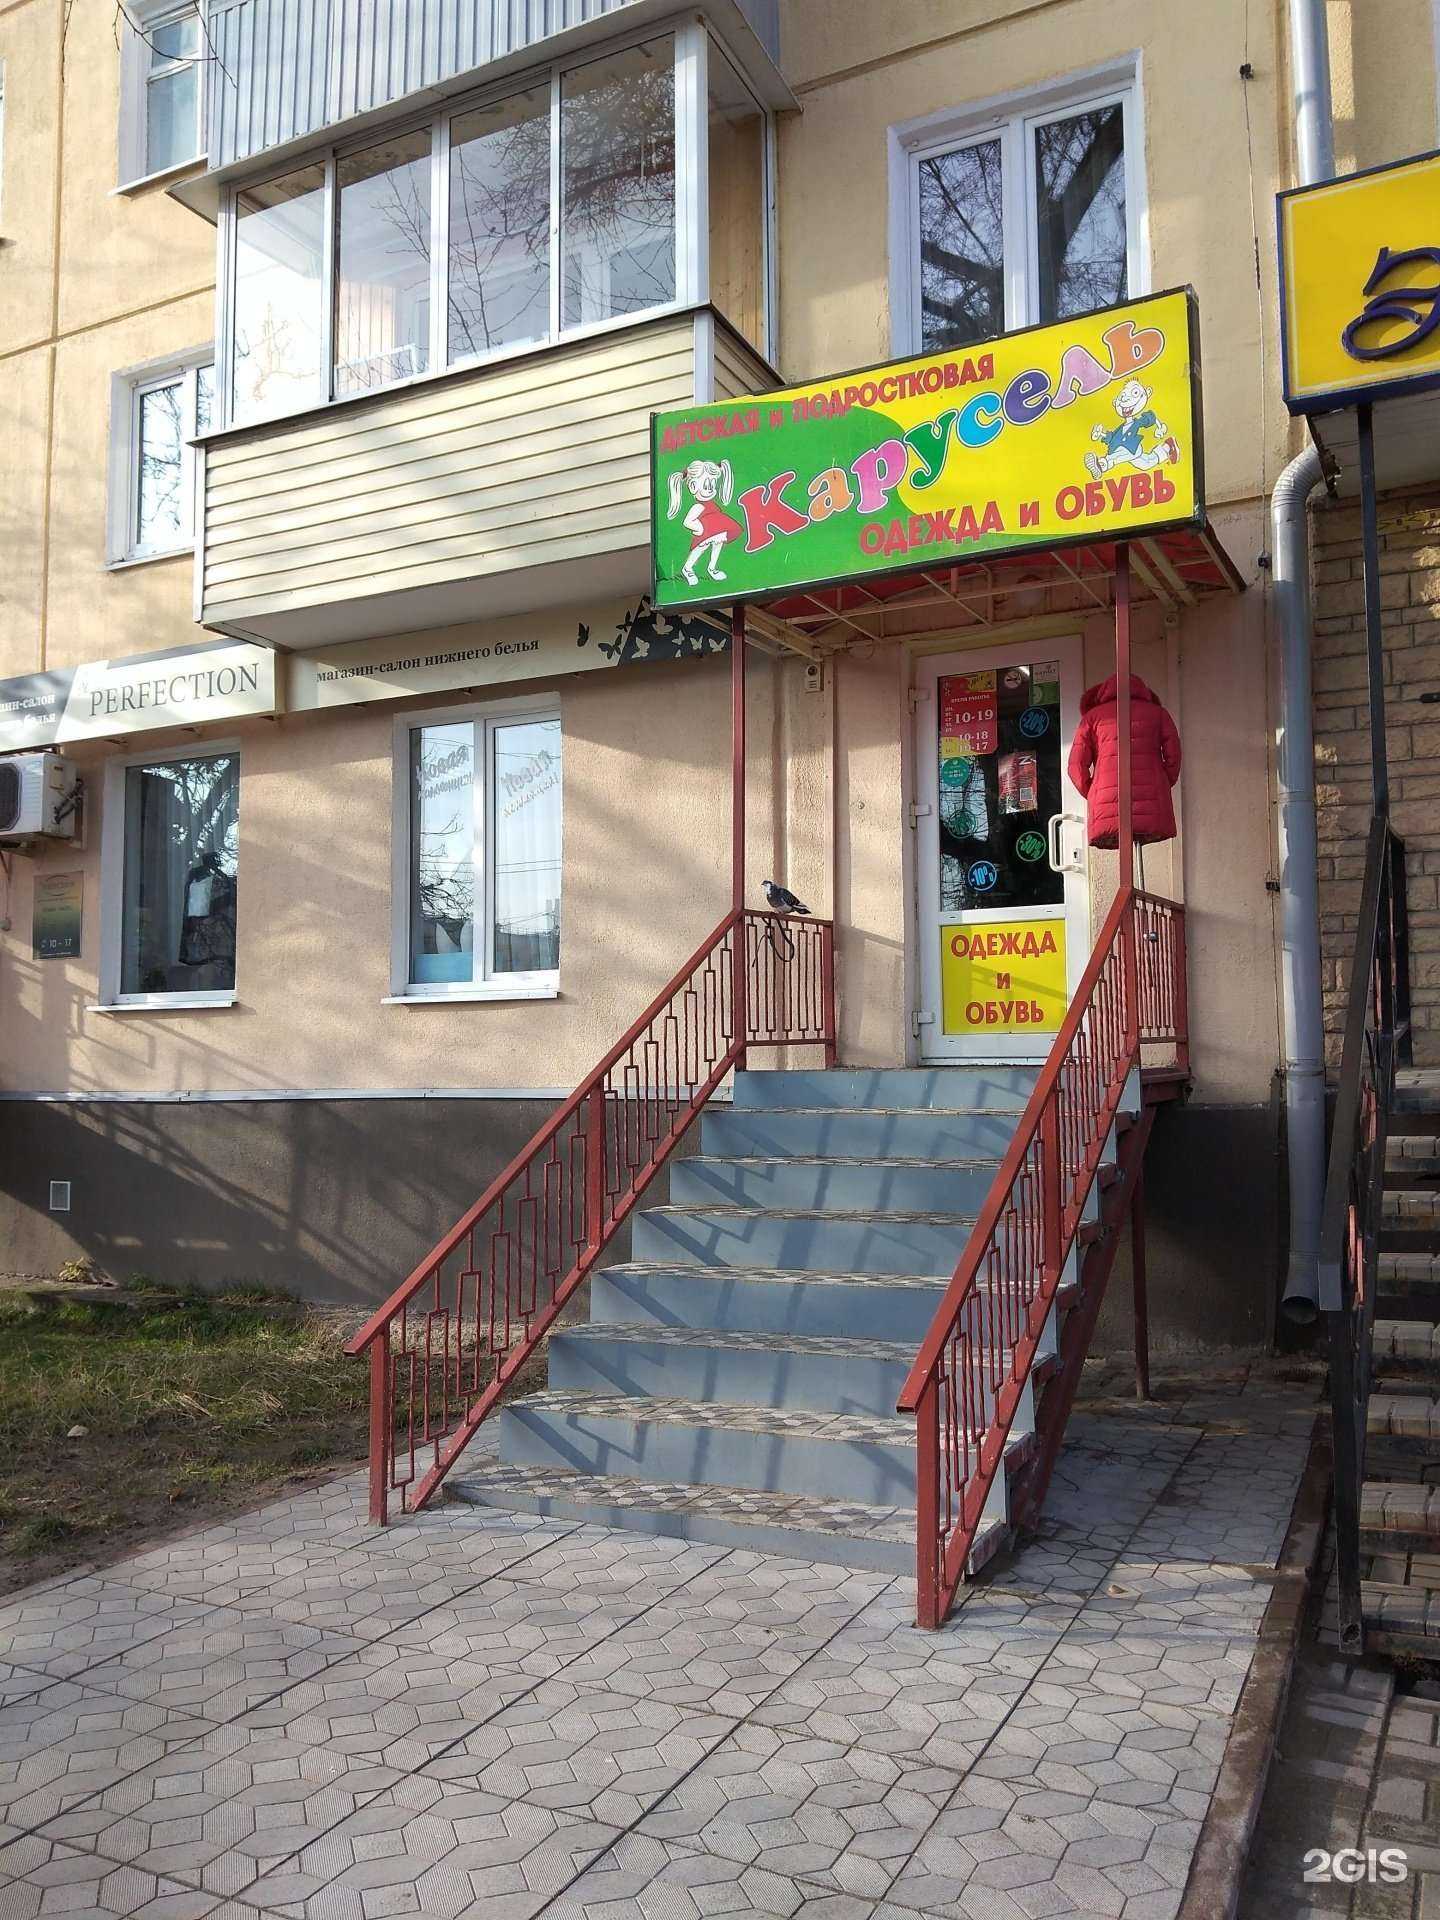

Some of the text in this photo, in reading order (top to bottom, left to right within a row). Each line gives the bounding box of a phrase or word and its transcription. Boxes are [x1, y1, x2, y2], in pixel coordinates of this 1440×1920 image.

[660, 408, 760, 454] ДЕТСКАЯ
[793, 353, 994, 424] ПОДРОСТКОВАЯ
[738, 320, 1165, 554] Карусель
[860, 501, 1004, 556] ОДЕЖДА
[1056, 469, 1175, 520] ОБУВЬ
[316, 639, 539, 683] магазин-салон нижнего белья
[89, 663, 260, 716] PERFECTION
[955, 709, 994, 724] 10-19
[959, 731, 989, 741] 10-18
[951, 930, 1057, 960] ОДЕЖДА
[965, 1000, 1044, 1024] ОБУВЬ
